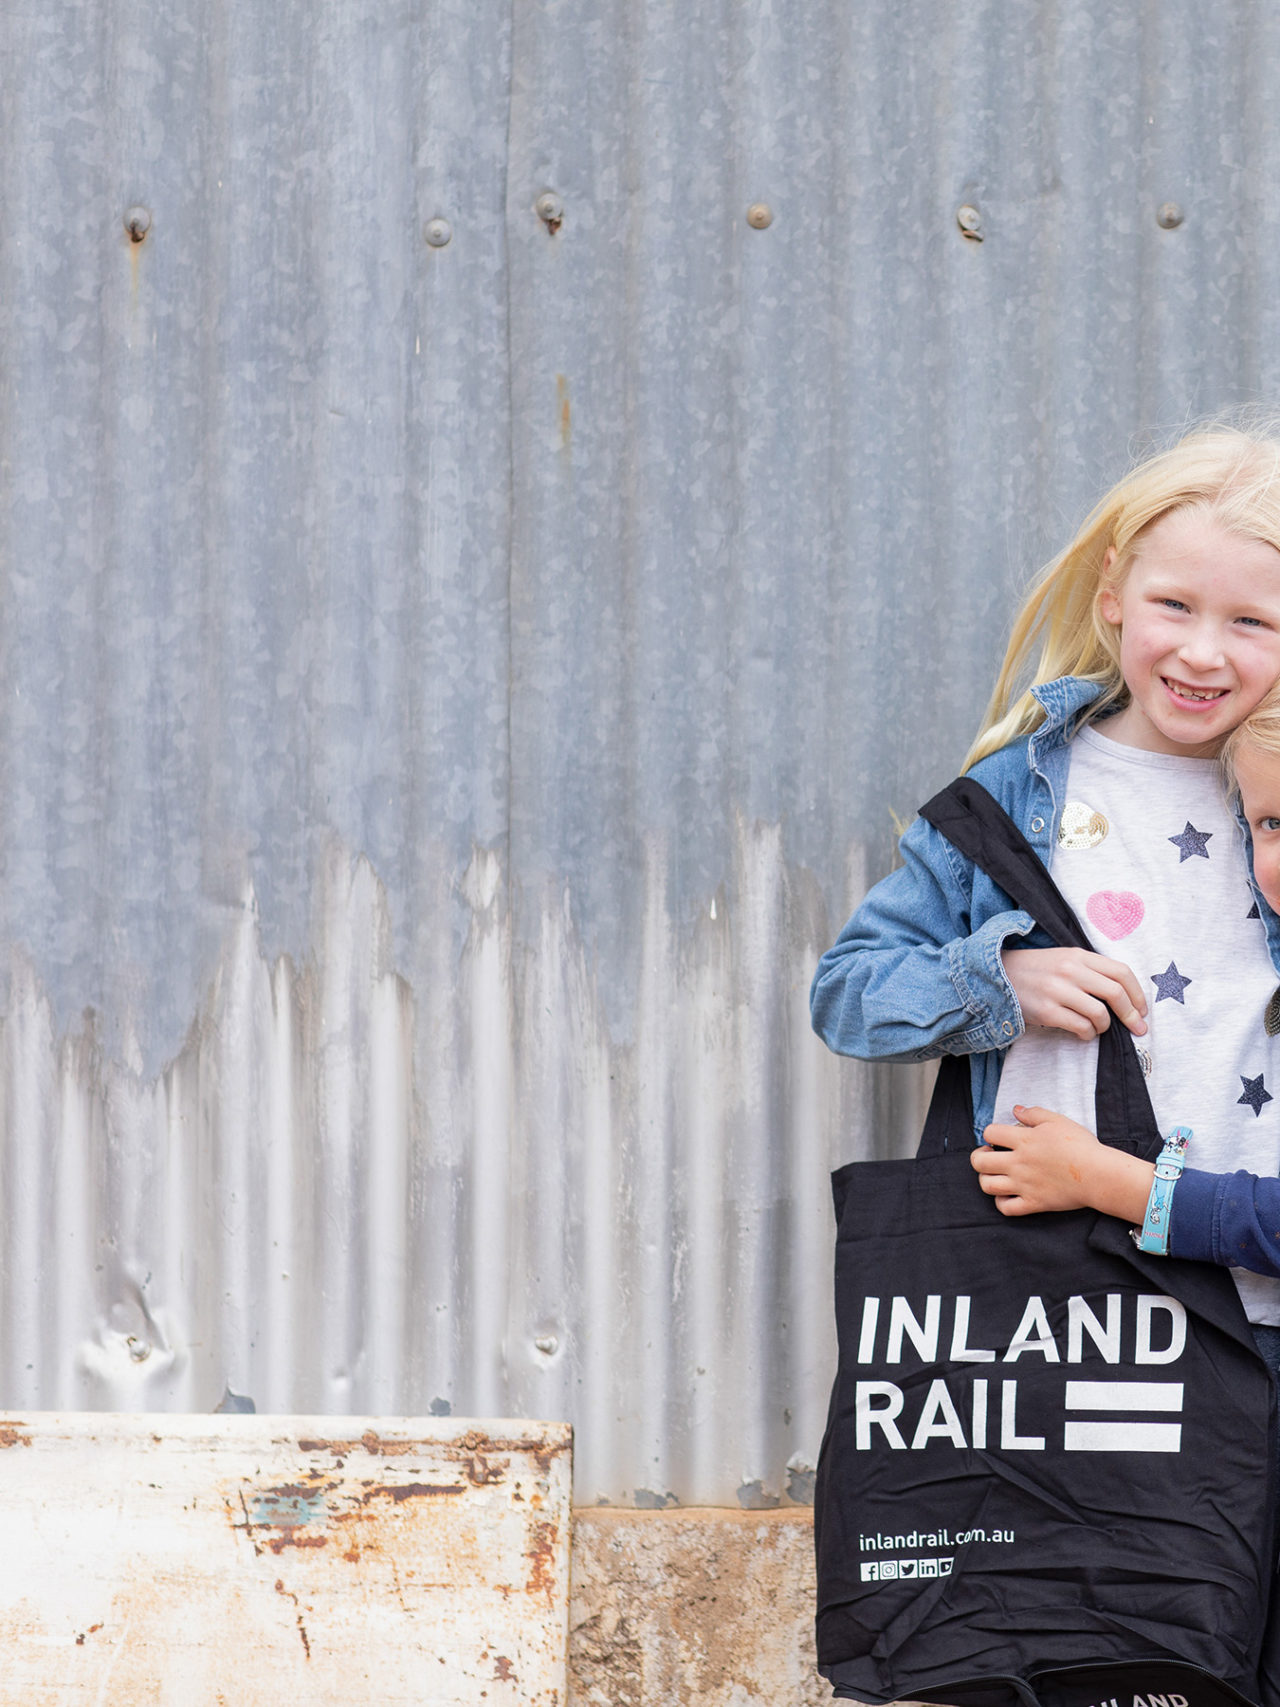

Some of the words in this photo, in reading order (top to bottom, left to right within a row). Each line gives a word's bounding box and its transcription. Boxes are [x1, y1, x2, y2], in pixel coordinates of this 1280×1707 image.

[857, 1293, 1187, 1365] INLAND
[855, 1378, 1046, 1451] RAIL
[859, 1528, 1015, 1552] inlandrail.com.au
